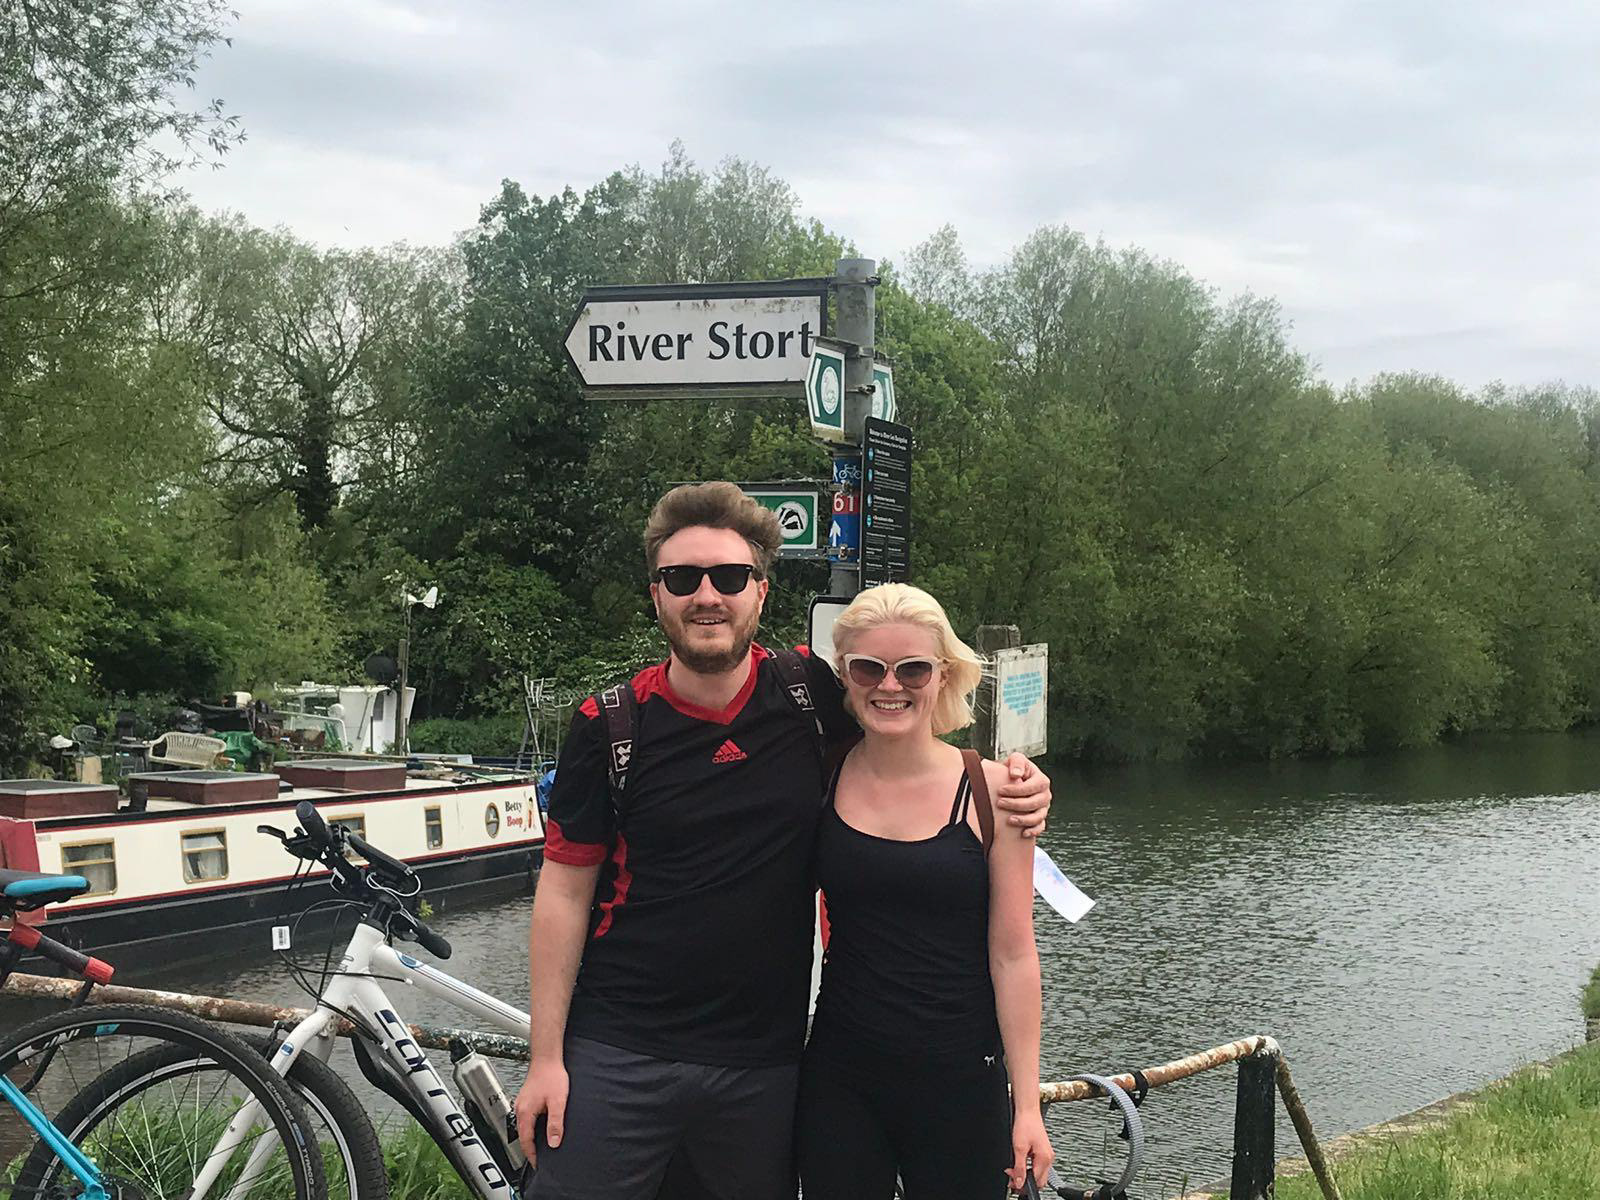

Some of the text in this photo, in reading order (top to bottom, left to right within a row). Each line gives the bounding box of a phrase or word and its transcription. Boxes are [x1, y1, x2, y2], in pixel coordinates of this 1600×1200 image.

[588, 321, 814, 362] River Stort
[833, 491, 855, 512] 61
[711, 751, 748, 764] adidas
[504, 800, 523, 813] Betty
